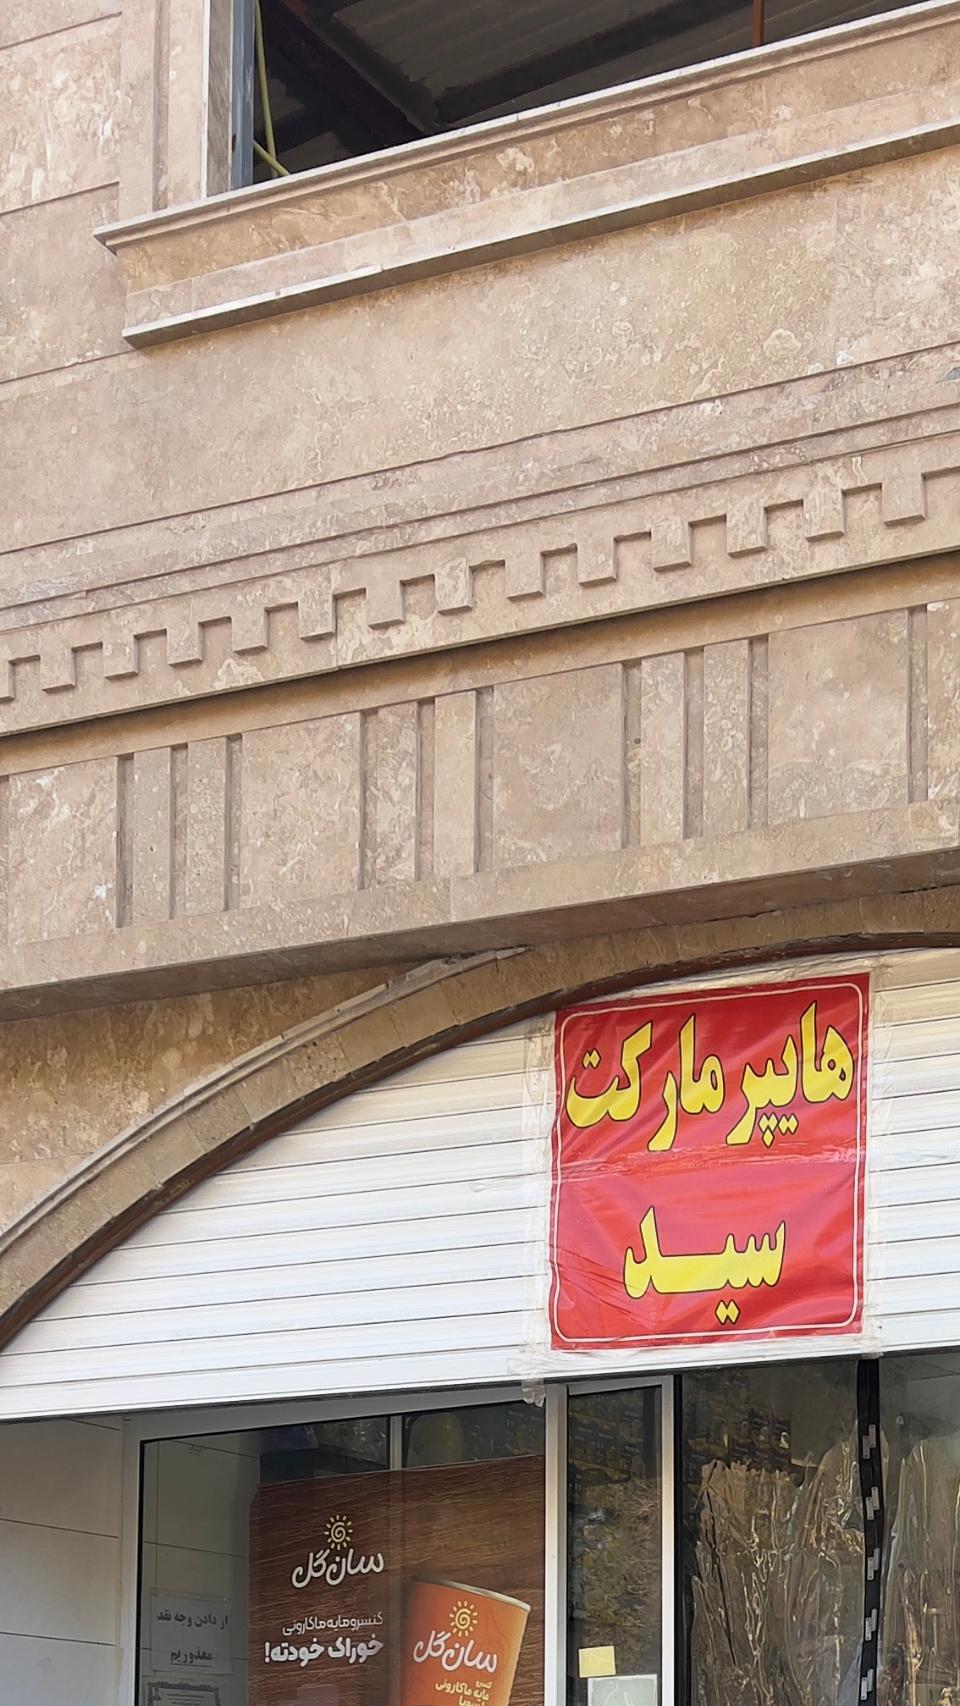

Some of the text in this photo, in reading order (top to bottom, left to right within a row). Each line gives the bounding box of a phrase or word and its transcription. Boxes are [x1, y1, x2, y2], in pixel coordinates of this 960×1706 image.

[566, 1000, 855, 1152] هایپر مارکت
[623, 1205, 786, 1325] سید
[157, 1608, 229, 1630] از دادن وجه نقد
[170, 1646, 213, 1665] معذوریم
[328, 1634, 383, 1664] خوراک
